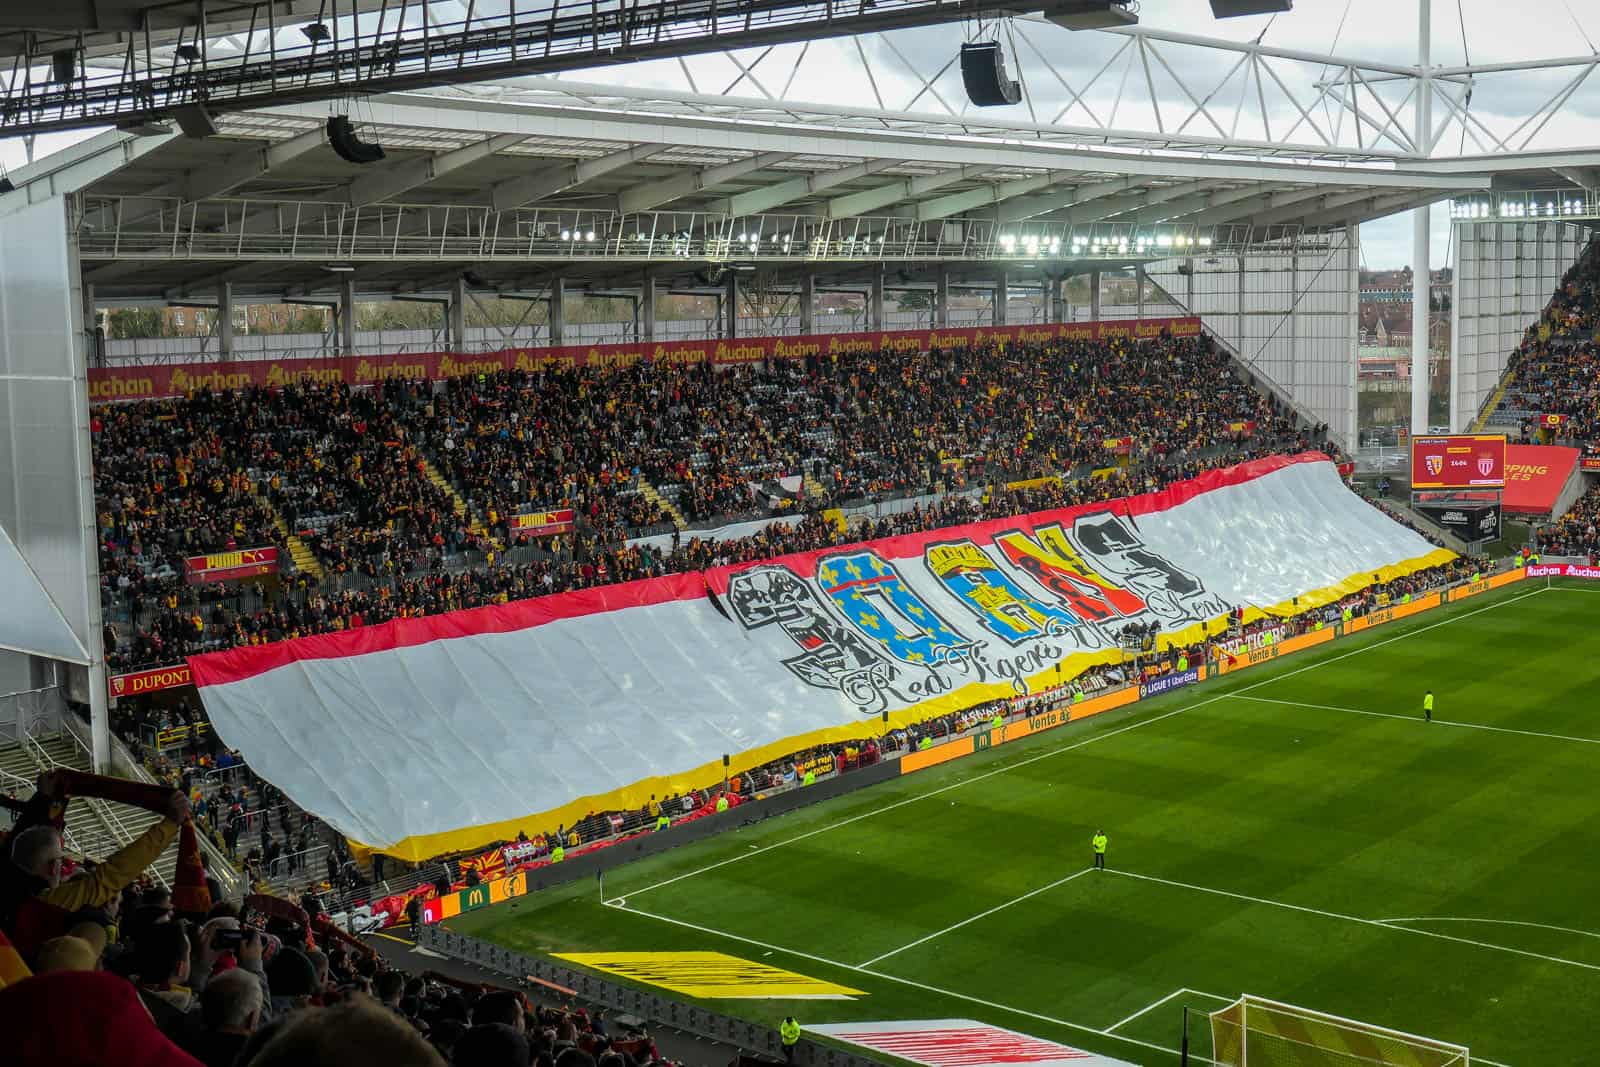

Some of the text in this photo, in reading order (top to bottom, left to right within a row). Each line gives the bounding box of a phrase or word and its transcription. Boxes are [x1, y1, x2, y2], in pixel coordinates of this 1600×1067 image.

[88, 374, 152, 396] uchan
[715, 342, 765, 361] Auchan
[774, 339, 820, 357] Auchan
[1527, 566, 1561, 577] Auchan
[133, 670, 191, 691] DUPONT
[1148, 680, 1167, 694] LIGUE
[1029, 712, 1057, 731] Vente
